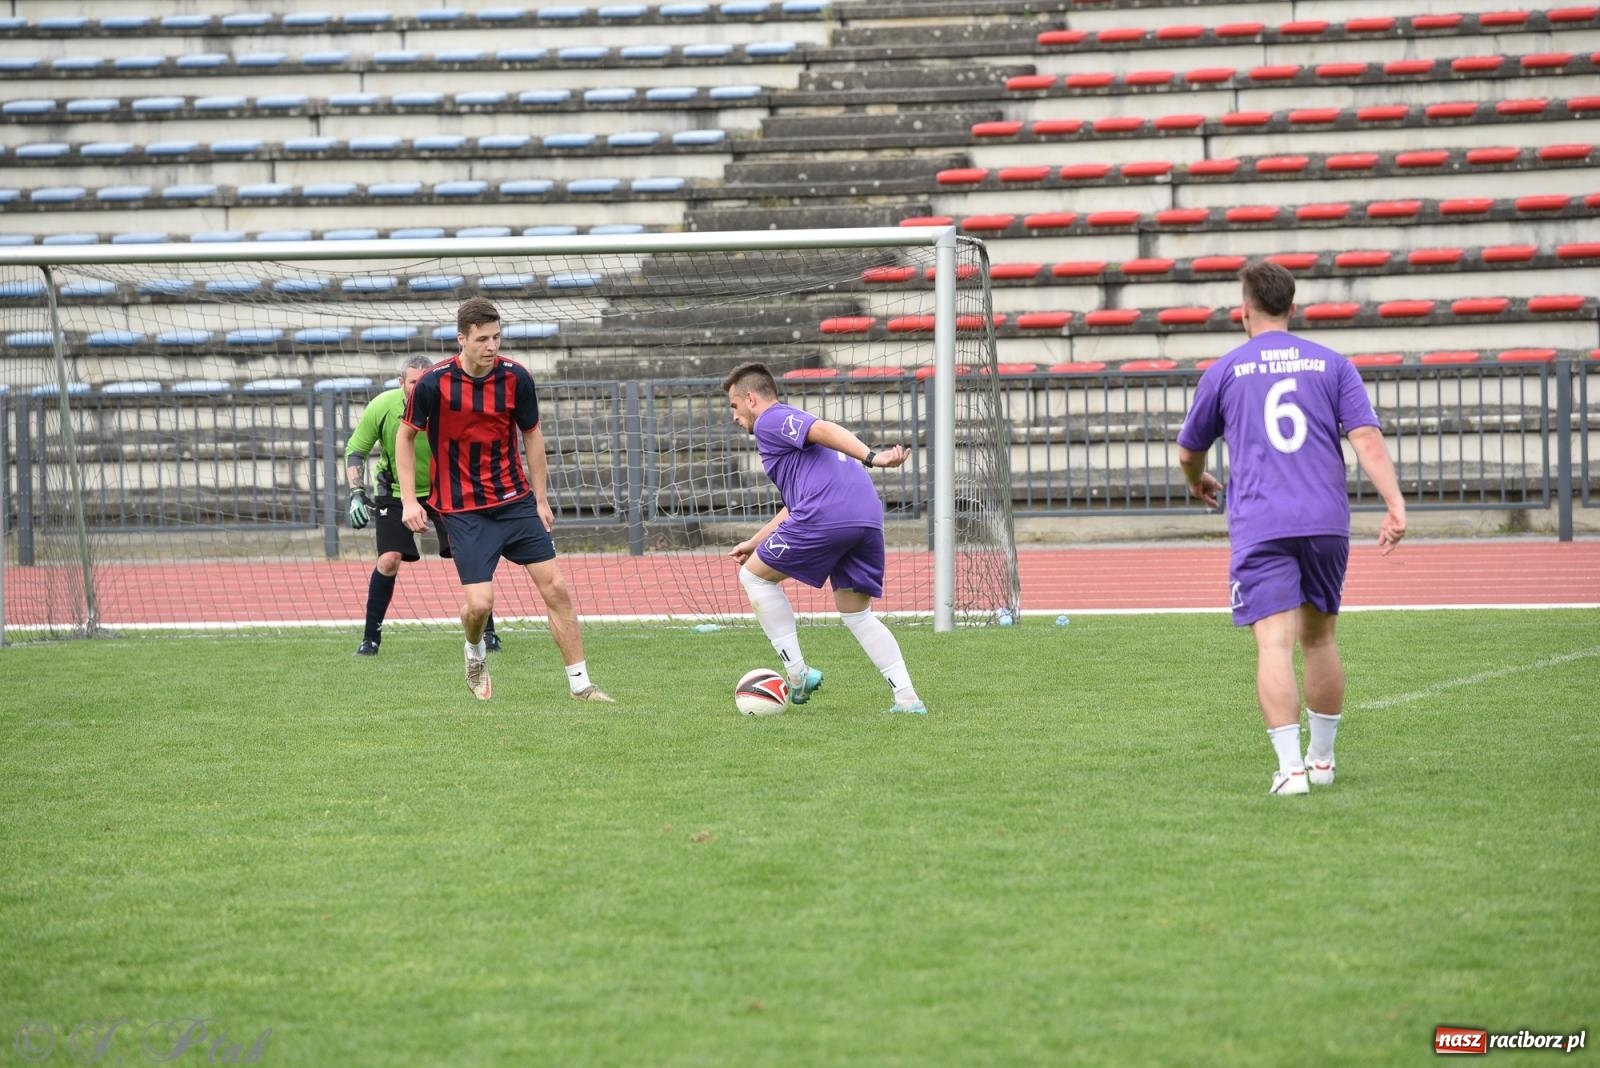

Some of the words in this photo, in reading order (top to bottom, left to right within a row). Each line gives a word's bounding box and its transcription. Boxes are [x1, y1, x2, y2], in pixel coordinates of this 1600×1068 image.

[1261, 347, 1299, 361] KONWÓJ
[1234, 363, 1256, 378] KWP
[1270, 359, 1325, 374] KATOWICACH
[1264, 378, 1307, 453] 6
